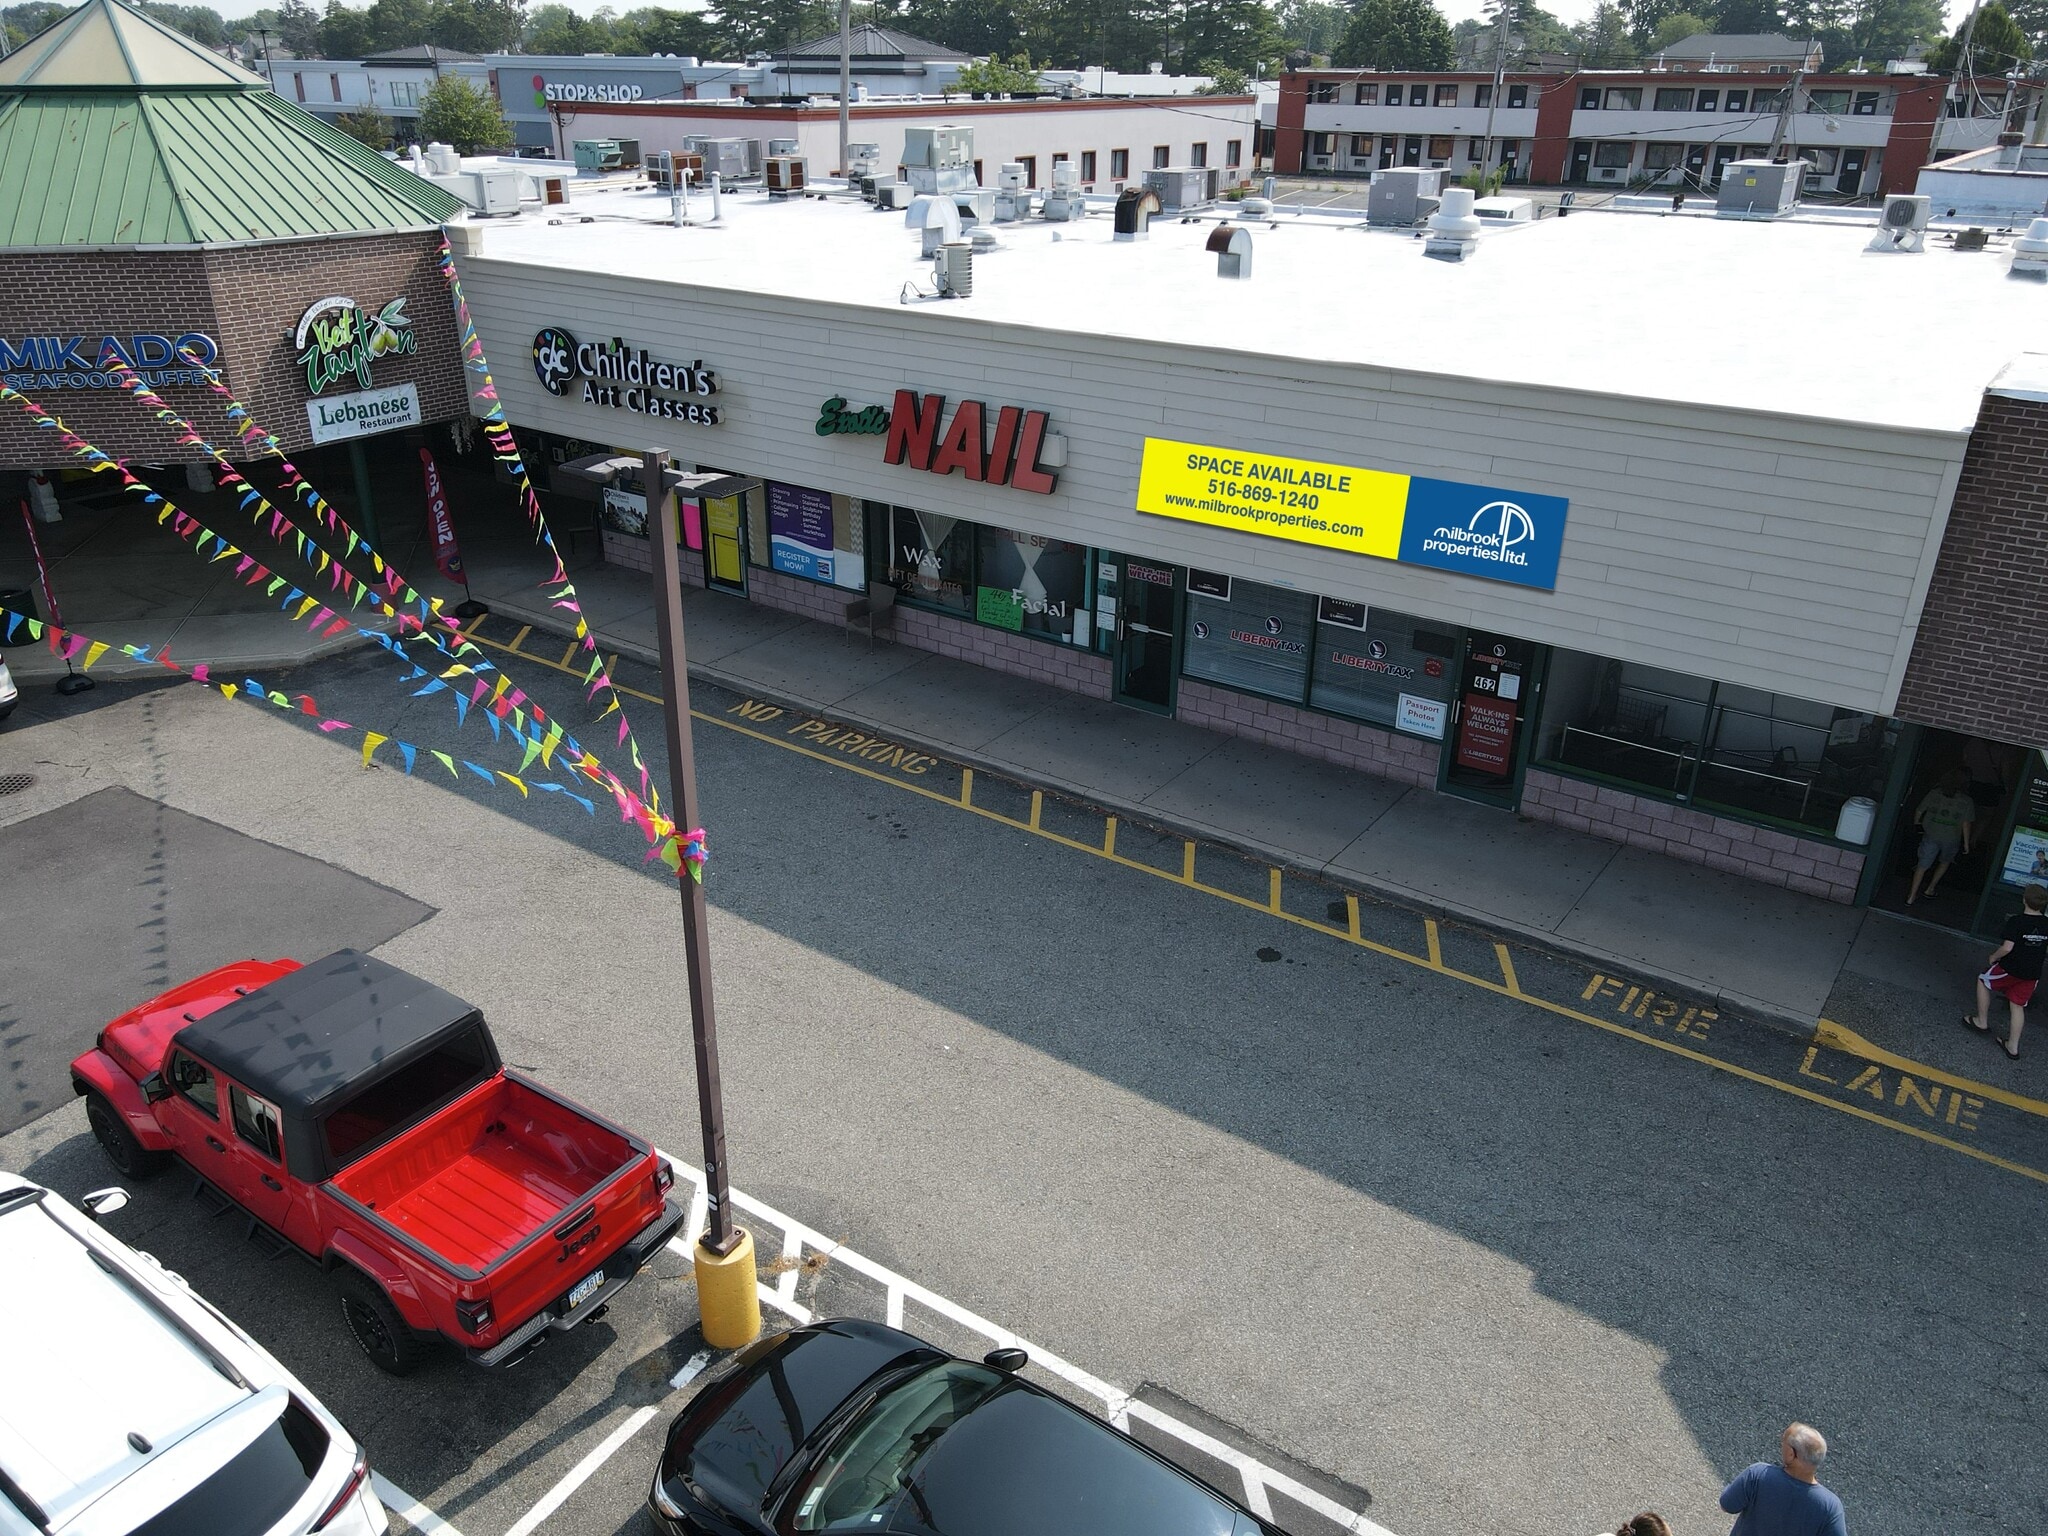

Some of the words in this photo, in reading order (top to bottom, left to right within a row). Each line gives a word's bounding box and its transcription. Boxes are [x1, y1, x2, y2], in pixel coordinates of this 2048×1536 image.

[545, 83, 643, 102] STOP&SHOP
[312, 308, 354, 354] Beit
[0, 333, 218, 371] MIKADO
[3, 370, 124, 390] SEAFOOD
[577, 338, 714, 396] Children's
[318, 396, 410, 427] Lebanese
[583, 380, 619, 408] Art
[626, 388, 715, 426] Classes
[360, 412, 412, 430] Restaurant
[883, 389, 1058, 495] NAIL
[1186, 454, 1244, 477] SPACE
[1247, 463, 1352, 493] AVAILABLE
[1207, 479, 1319, 511] 516-869-1240
[432, 499, 454, 545] OPEN
[1164, 493, 1364, 537] www.milbrookproperties.com
[1433, 526, 1501, 547] milbrook
[777, 549, 811, 564] REGISTER
[903, 544, 942, 570] Wax
[1422, 539, 1499, 561] properties
[1505, 550, 1529, 566] ltd.
[784, 560, 805, 572] NOW!
[1128, 569, 1172, 586] WELCOME
[1010, 588, 1066, 619] Facial
[1475, 676, 1495, 691] 462
[1406, 699, 1440, 714] Passport
[1408, 709, 1435, 722] Photos
[1470, 705, 1510, 720] WALK-INS
[1402, 717, 1420, 727] Taken
[1421, 722, 1436, 730] Here
[1466, 719, 1510, 735] WELCOME
[1471, 713, 1506, 727] ALWAYS
[726, 699, 783, 722] NO
[787, 719, 931, 774] PARKING
[2033, 778, 2048, 787] Sto
[2013, 846, 2033, 856] Clinic
[1581, 973, 1719, 1040] FIRE
[1799, 1046, 1984, 1132] LANE
[557, 1224, 601, 1262] Jeep
